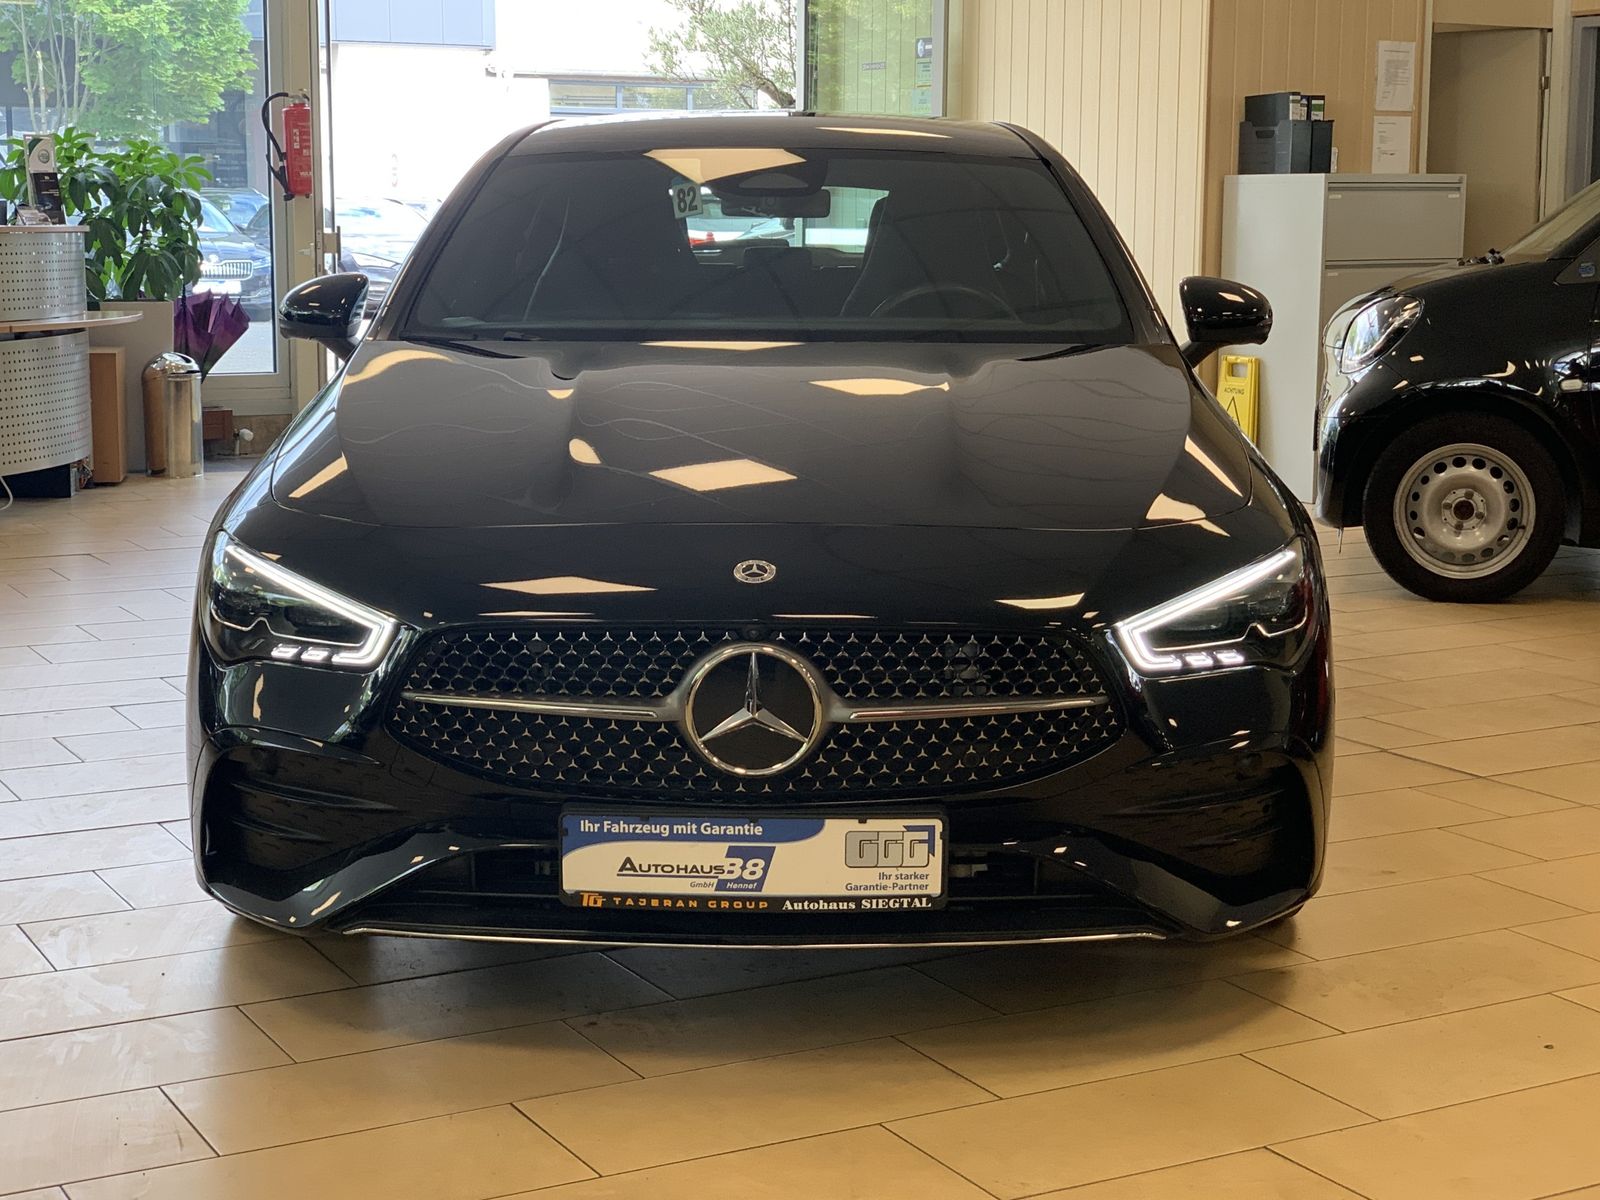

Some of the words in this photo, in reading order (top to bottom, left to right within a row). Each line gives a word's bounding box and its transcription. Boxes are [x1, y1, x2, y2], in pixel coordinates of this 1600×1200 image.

[677, 186, 698, 213] 82
[1224, 386, 1245, 395] ACHTUNG
[580, 820, 600, 833] Ihr
[603, 820, 670, 837] Fahrzeug
[673, 822, 697, 835] mit
[700, 822, 763, 836] Garantie
[878, 872, 892, 881] Ihr
[894, 872, 930, 881] starker
[690, 881, 715, 889] GmbH
[726, 881, 757, 890] Hennef
[845, 883, 930, 892] Garantie-Partner
[613, 897, 698, 908] TAJERAN
[707, 900, 769, 909] GROUP
[782, 899, 856, 911] Autohaus
[861, 898, 932, 910] SIEGTAL
